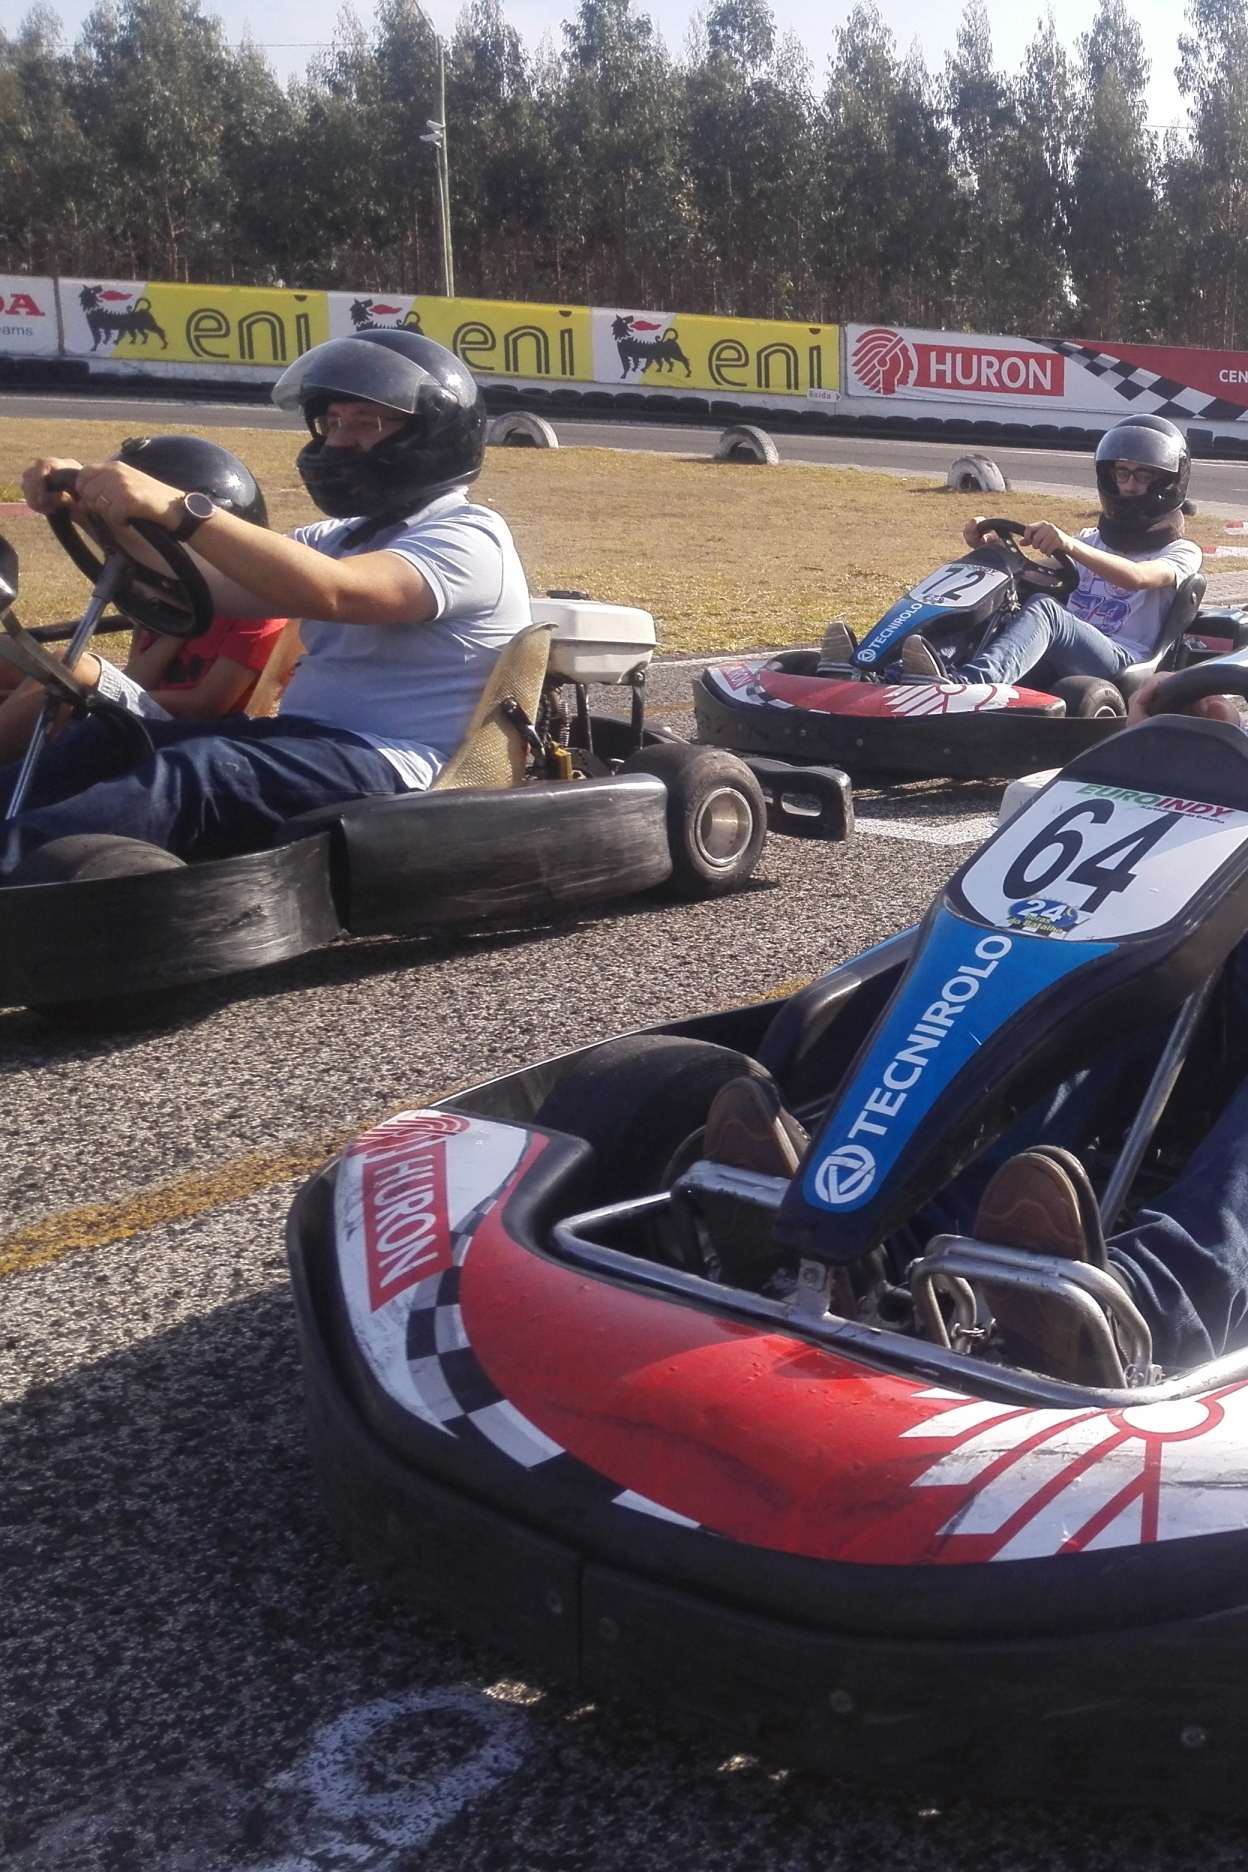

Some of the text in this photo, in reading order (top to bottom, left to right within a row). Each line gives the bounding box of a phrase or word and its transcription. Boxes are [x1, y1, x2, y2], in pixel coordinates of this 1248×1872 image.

[186, 295, 312, 361] eni
[452, 310, 574, 376] eni
[708, 328, 822, 390] eni
[930, 351, 1052, 390] HURON
[922, 568, 986, 601] 72
[868, 602, 923, 649] TECNIROLO
[1075, 784, 1235, 817] EUROINDY
[1002, 798, 1184, 913] 64
[1016, 899, 1068, 922] 24
[848, 935, 1013, 1138] TECNIROLO
[372, 1154, 438, 1289] HURON
